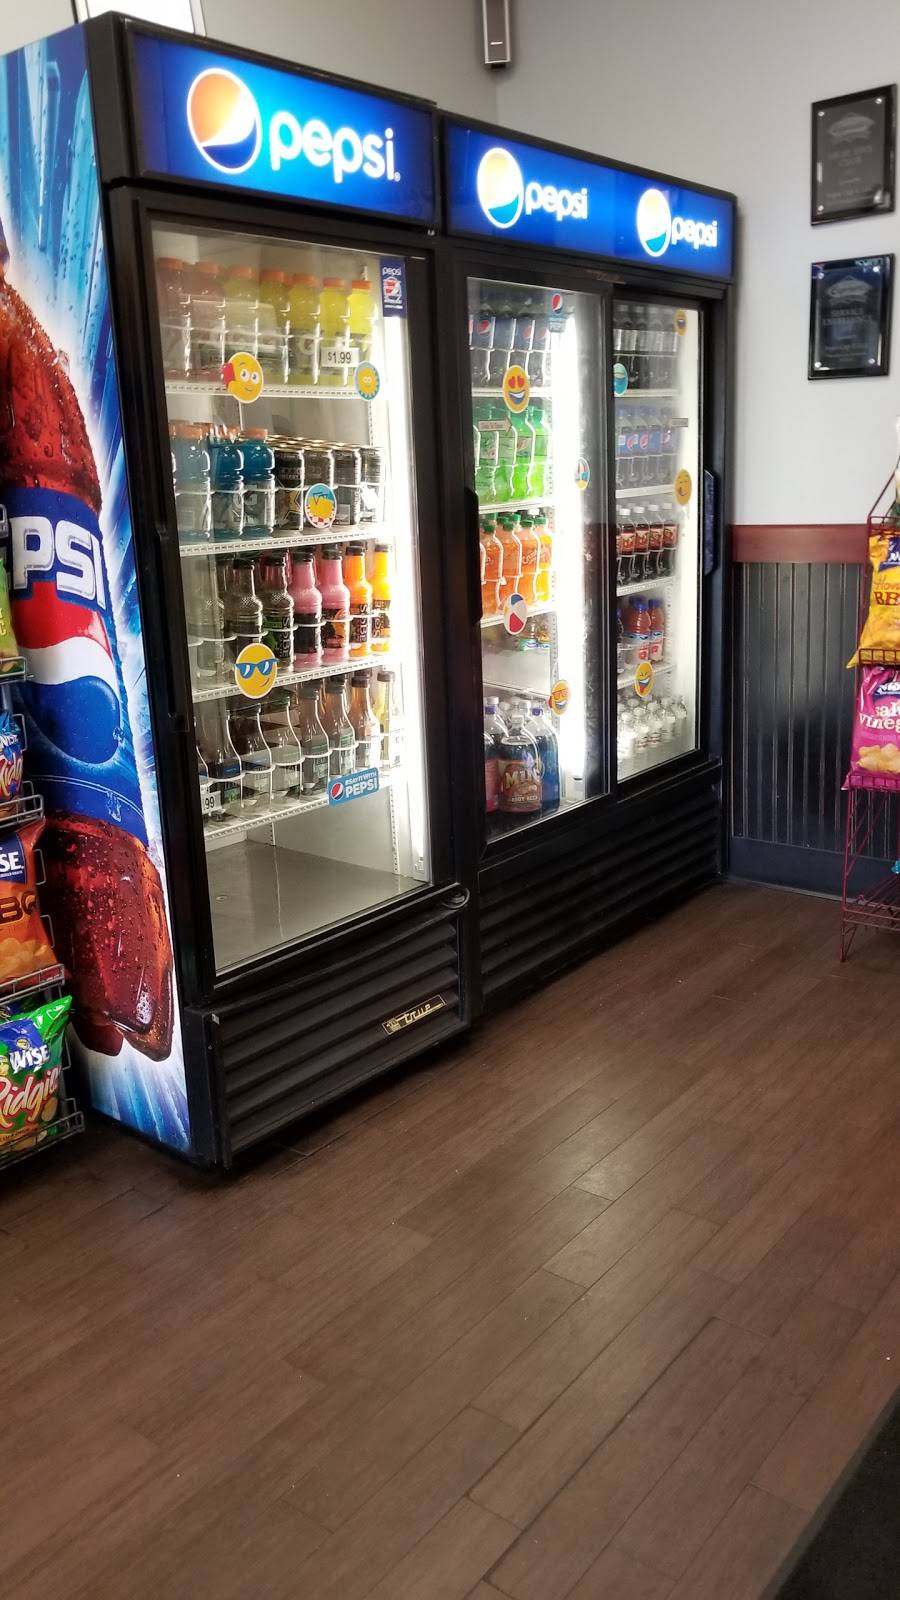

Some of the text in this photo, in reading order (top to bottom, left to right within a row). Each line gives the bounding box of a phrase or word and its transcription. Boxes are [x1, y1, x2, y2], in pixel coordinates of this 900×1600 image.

[268, 111, 396, 184] pepsi
[525, 181, 588, 222] pepsi
[671, 216, 718, 250] pepsi
[327, 351, 352, 364] $1.99
[345, 778, 378, 799] PEPSI
[10, 1044, 50, 1075] WISE
